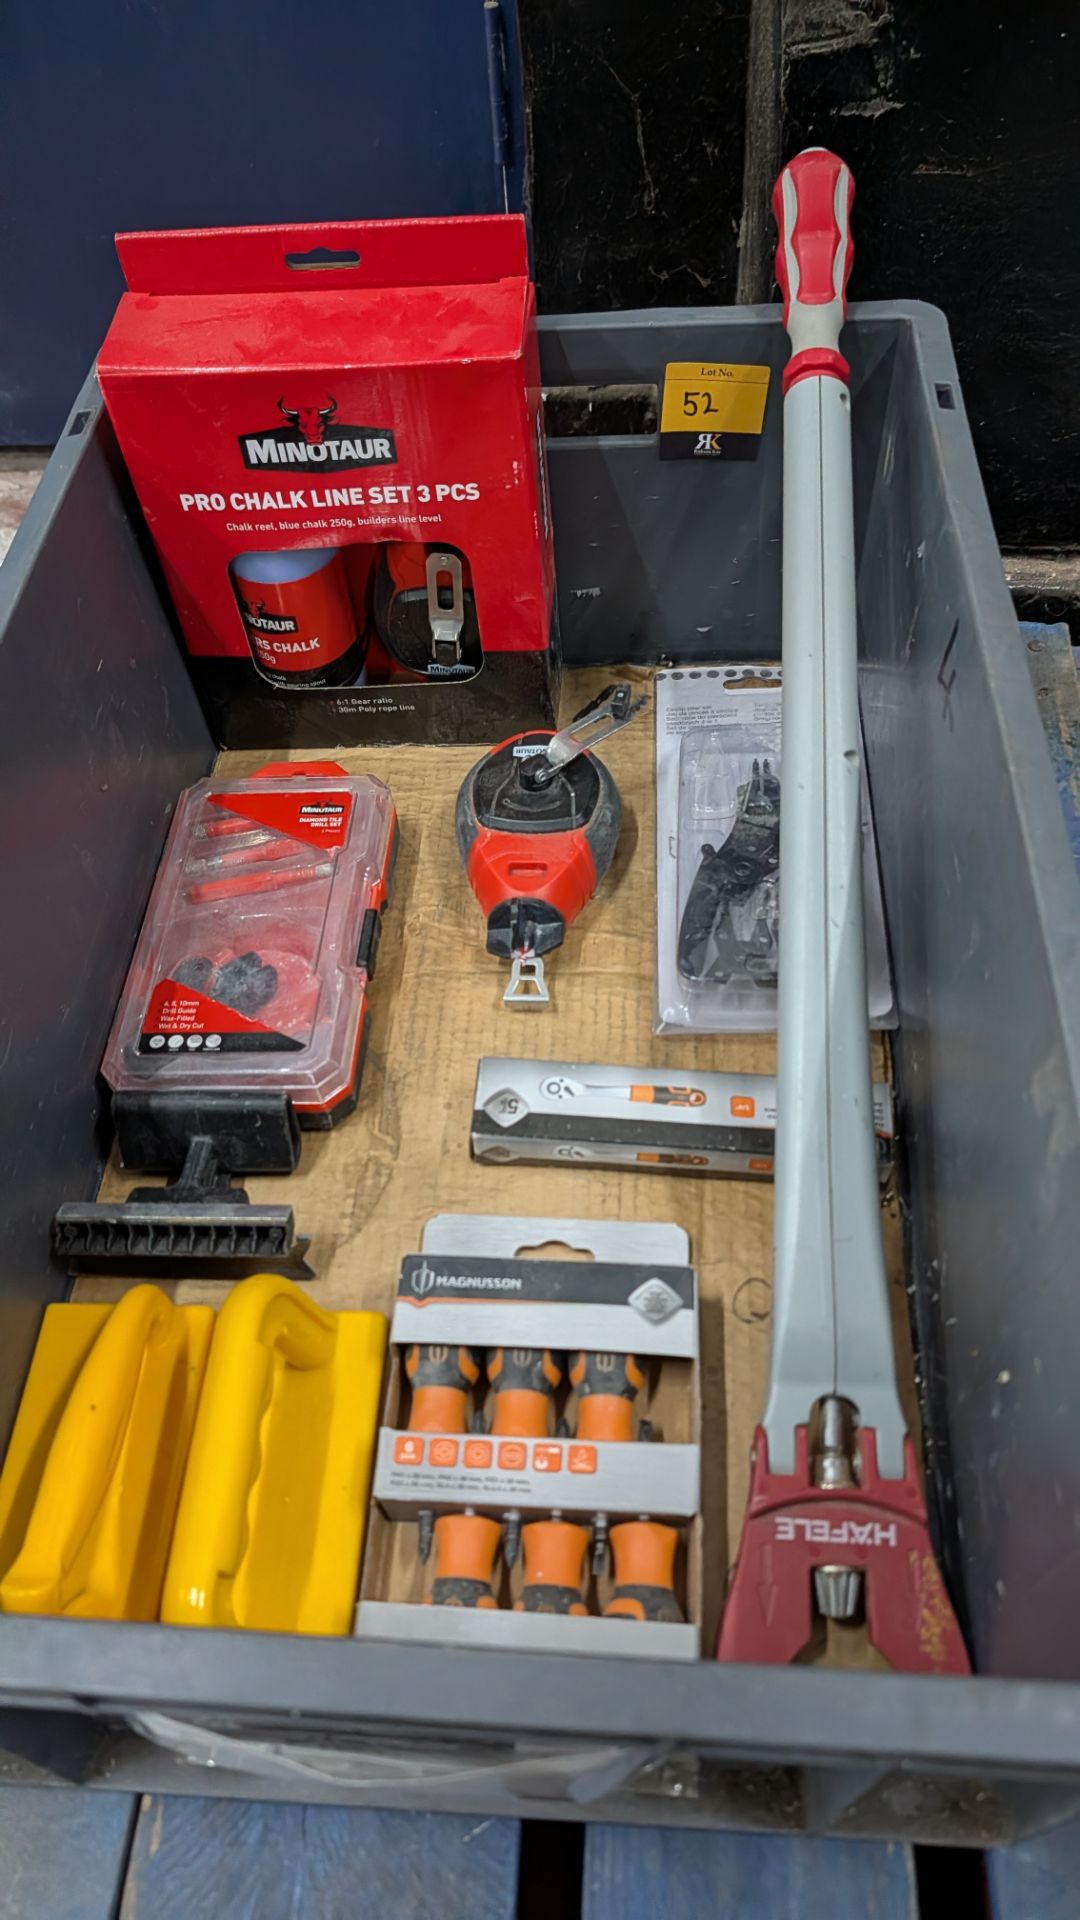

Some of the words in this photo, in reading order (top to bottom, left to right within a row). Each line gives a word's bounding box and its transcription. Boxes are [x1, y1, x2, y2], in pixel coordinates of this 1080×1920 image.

[700, 368, 716, 376] Lot
[718, 368, 734, 377] No.
[683, 391, 719, 416] 52
[245, 438, 392, 465] MINOTAUR
[179, 493, 226, 512] PRO
[229, 489, 308, 511] CHALK
[311, 487, 365, 507] LINE
[368, 485, 411, 504] SET
[417, 485, 430, 502] 3
[436, 482, 480, 501] PCS
[226, 522, 253, 532] Chalk
[255, 521, 277, 532] reel,
[279, 520, 300, 530] blue
[302, 519, 328, 529] chalk
[330, 518, 356, 530] 250g,
[357, 515, 397, 527] builders
[399, 514, 416, 525] line
[418, 513, 442, 523] level
[273, 636, 321, 653] CHALK
[358, 706, 377, 714] Poly
[379, 705, 397, 713] rope
[435, 1275, 523, 1290] MAGNUSSON
[773, 1515, 897, 1547] HÄFELE
